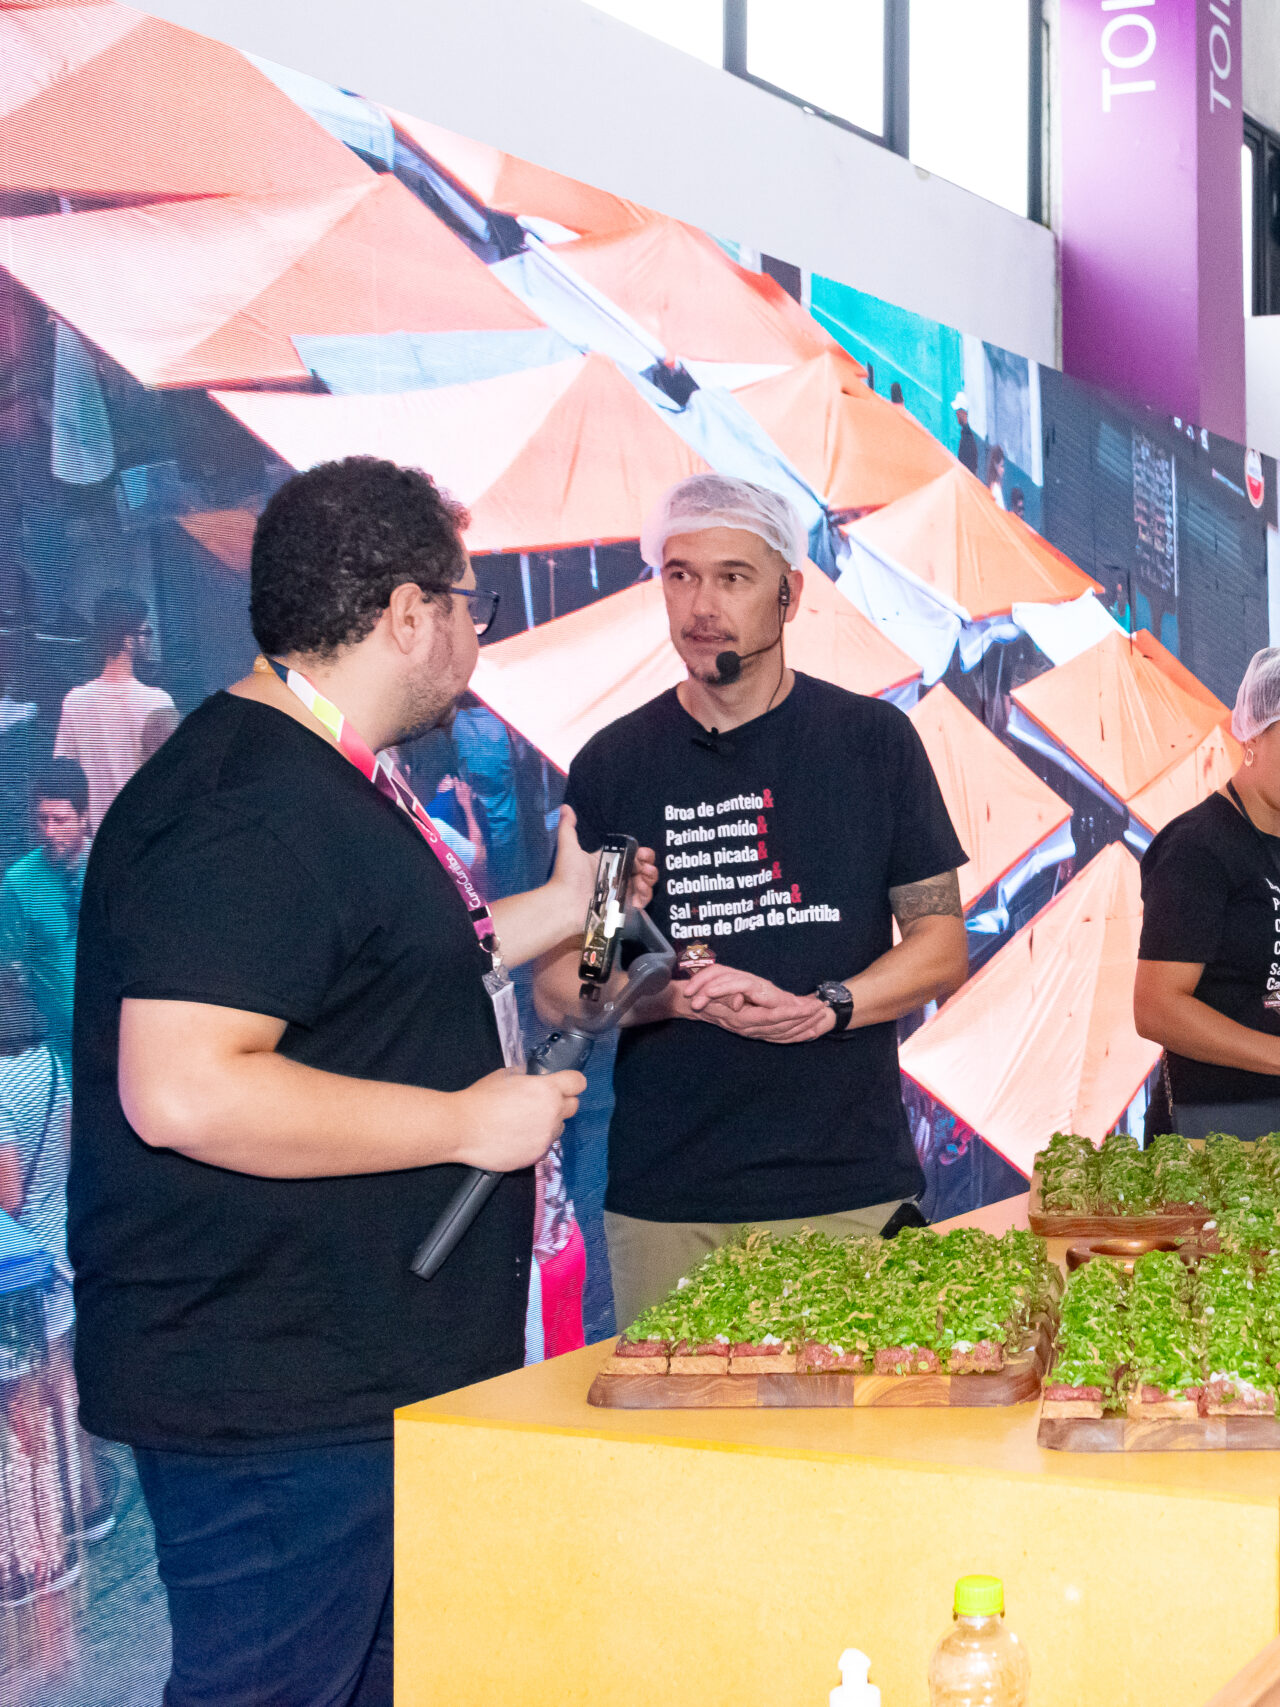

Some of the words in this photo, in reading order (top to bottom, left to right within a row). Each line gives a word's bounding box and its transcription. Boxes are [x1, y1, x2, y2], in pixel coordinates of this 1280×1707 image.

[665, 805, 695, 821] Broa
[697, 802, 714, 818] de
[666, 825, 716, 847] Patinho
[665, 851, 711, 871] Cebola
[667, 874, 735, 895] Cebolinha
[669, 902, 691, 921] Sal
[699, 899, 754, 921] pimenta
[671, 922, 711, 939] Carne
[714, 920, 733, 935] de
[734, 913, 765, 933] Onça
[767, 909, 785, 926] de
